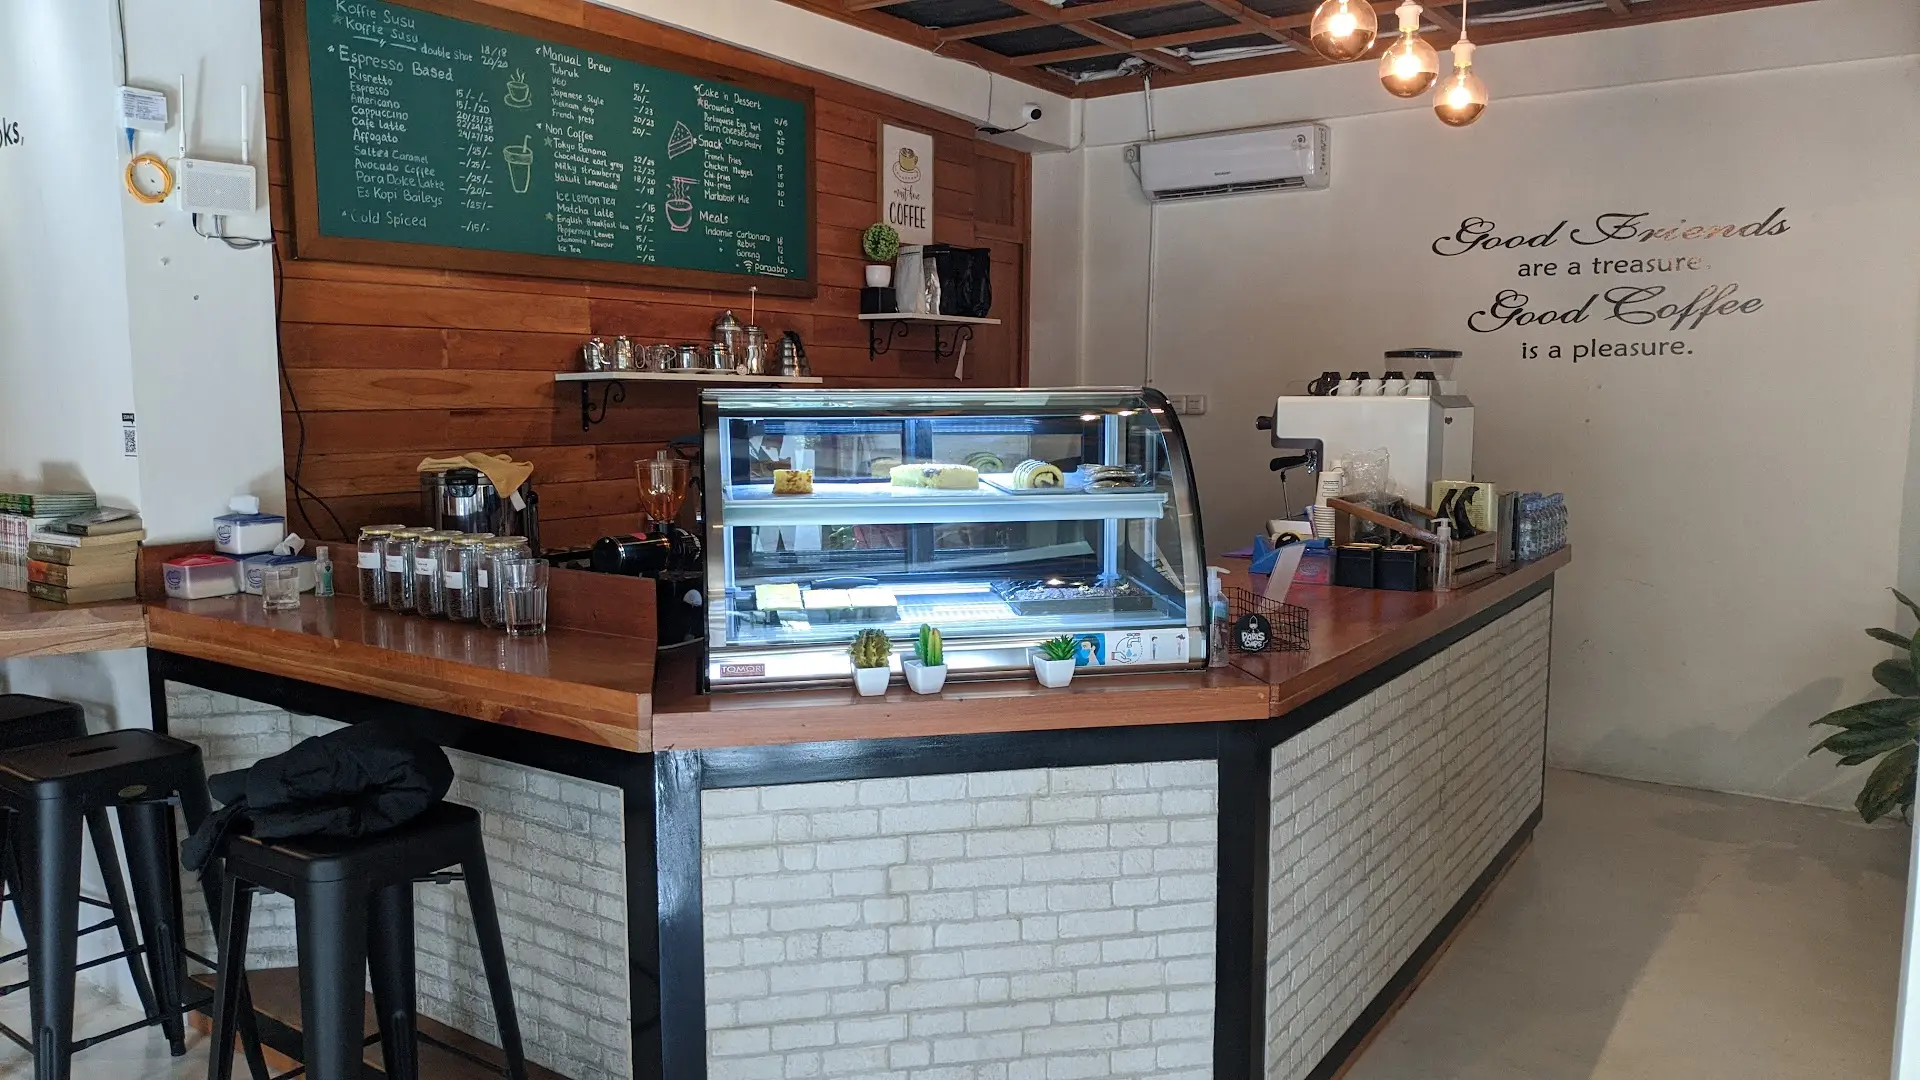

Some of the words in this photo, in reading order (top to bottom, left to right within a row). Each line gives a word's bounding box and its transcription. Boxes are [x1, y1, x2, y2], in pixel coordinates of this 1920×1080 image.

[336, 0, 376, 19] Koffie
[383, 10, 415, 30] Susu
[345, 16, 383, 36] Koffie
[391, 29, 418, 44] Susu
[421, 43, 450, 60] double
[454, 51, 473, 62] shot
[543, 45, 582, 67] Manual
[588, 57, 612, 73] Brew
[339, 44, 404, 72] Espresso
[412, 61, 454, 83] Based
[550, 63, 580, 78] Tubruk
[350, 81, 389, 98] Espresso
[551, 87, 583, 101] Japanese
[698, 83, 720, 99] Cake
[734, 93, 762, 110] Dessert
[351, 93, 400, 109] Americano
[704, 100, 735, 115] Brownies
[351, 105, 409, 121] Cappuccino
[552, 108, 576, 120] French
[352, 116, 375, 130] Cafe
[0, 117, 24, 148] ks,
[353, 127, 399, 145] Affogato
[545, 123, 564, 138] Non
[567, 126, 594, 143] Coffee
[553, 137, 575, 152] Tokyo
[578, 143, 607, 157] Banana
[698, 135, 724, 150] Snack
[354, 145, 388, 158] Salted
[391, 150, 428, 164] Caramel
[553, 151, 590, 164] Chocolate
[355, 158, 399, 172] Avocado
[554, 162, 577, 175] Milky
[703, 161, 729, 173] Chicken
[554, 172, 581, 184] Yakult
[357, 186, 370, 199] Es
[373, 186, 397, 203] Kopi
[403, 189, 443, 208] Baileys
[572, 193, 600, 205] Lemon
[557, 203, 589, 216] Matcha
[699, 210, 729, 225] Meals
[889, 202, 926, 229] COFFEE
[386, 211, 427, 228] Spiced
[556, 214, 583, 227] English
[705, 226, 734, 238] Indomie
[1431, 216, 1567, 257] Good
[1569, 206, 1790, 246] Friends
[1517, 260, 1557, 278] are
[1566, 260, 1582, 276] a
[1467, 288, 1599, 334] Good
[1602, 283, 1764, 332] Coffee
[1521, 341, 1538, 360] is
[1547, 344, 1562, 359] a
[1572, 338, 1694, 364] pleasure.
